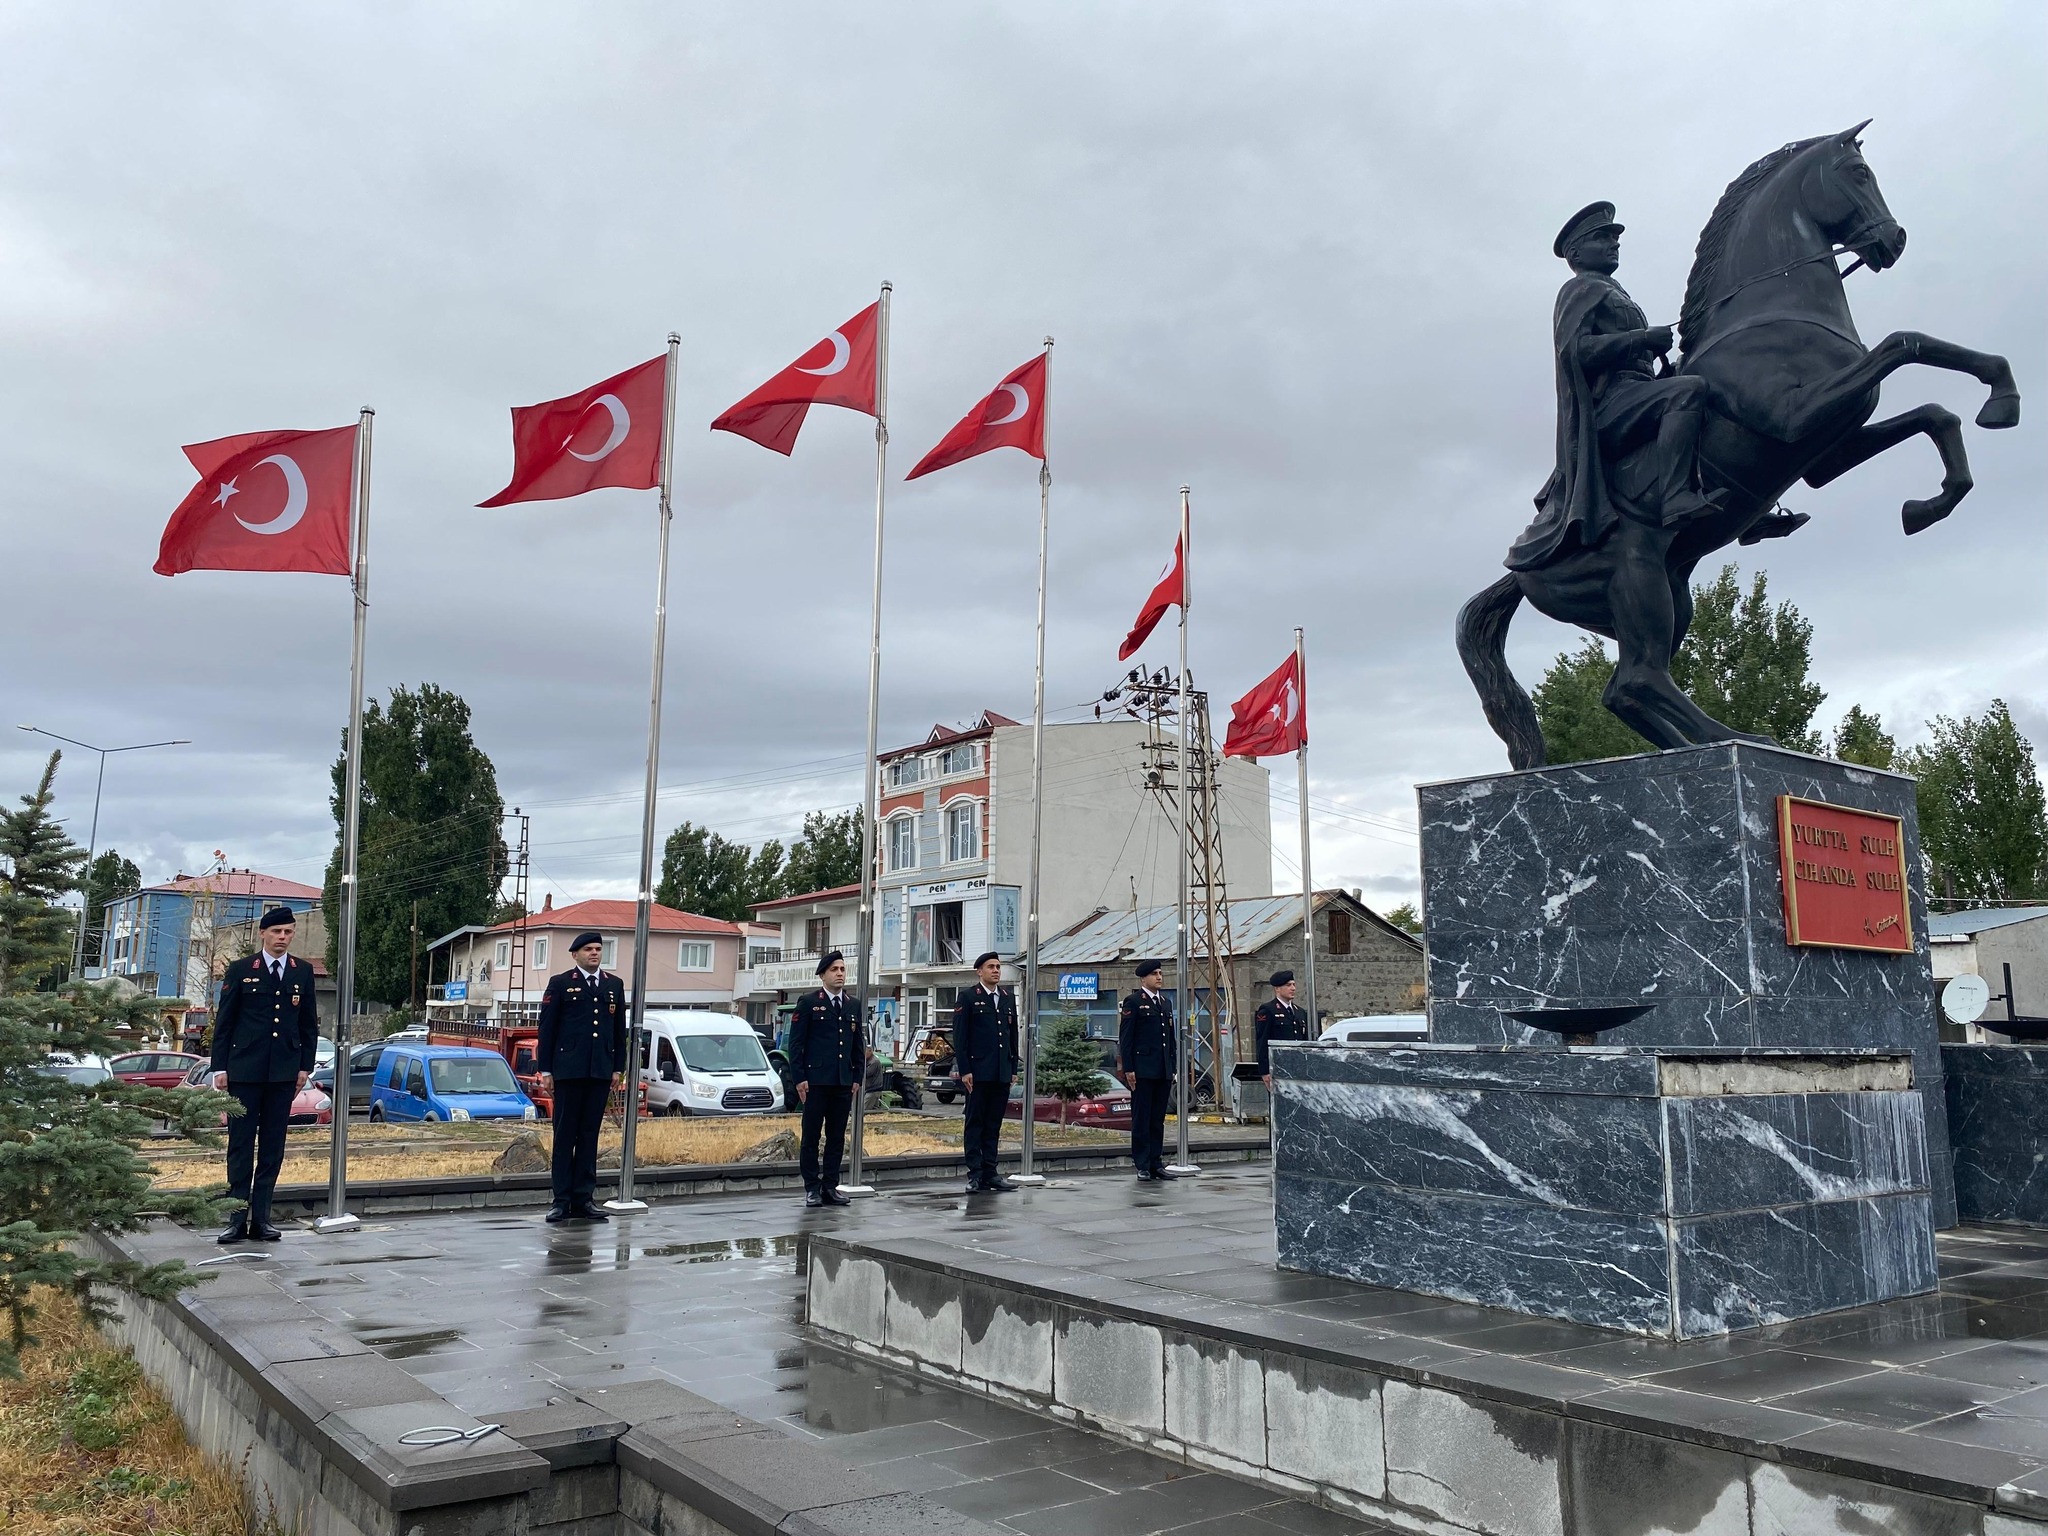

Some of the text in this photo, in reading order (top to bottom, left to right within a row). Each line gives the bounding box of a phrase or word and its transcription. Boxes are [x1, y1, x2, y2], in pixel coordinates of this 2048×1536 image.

[1792, 823, 1895, 857] YURTTA SULH
[1794, 859, 1900, 892] CİHANDA SULH
[929, 884, 946, 893] PEN
[967, 879, 986, 888] PEN
[1071, 976, 1096, 986] ARPAÇAY
